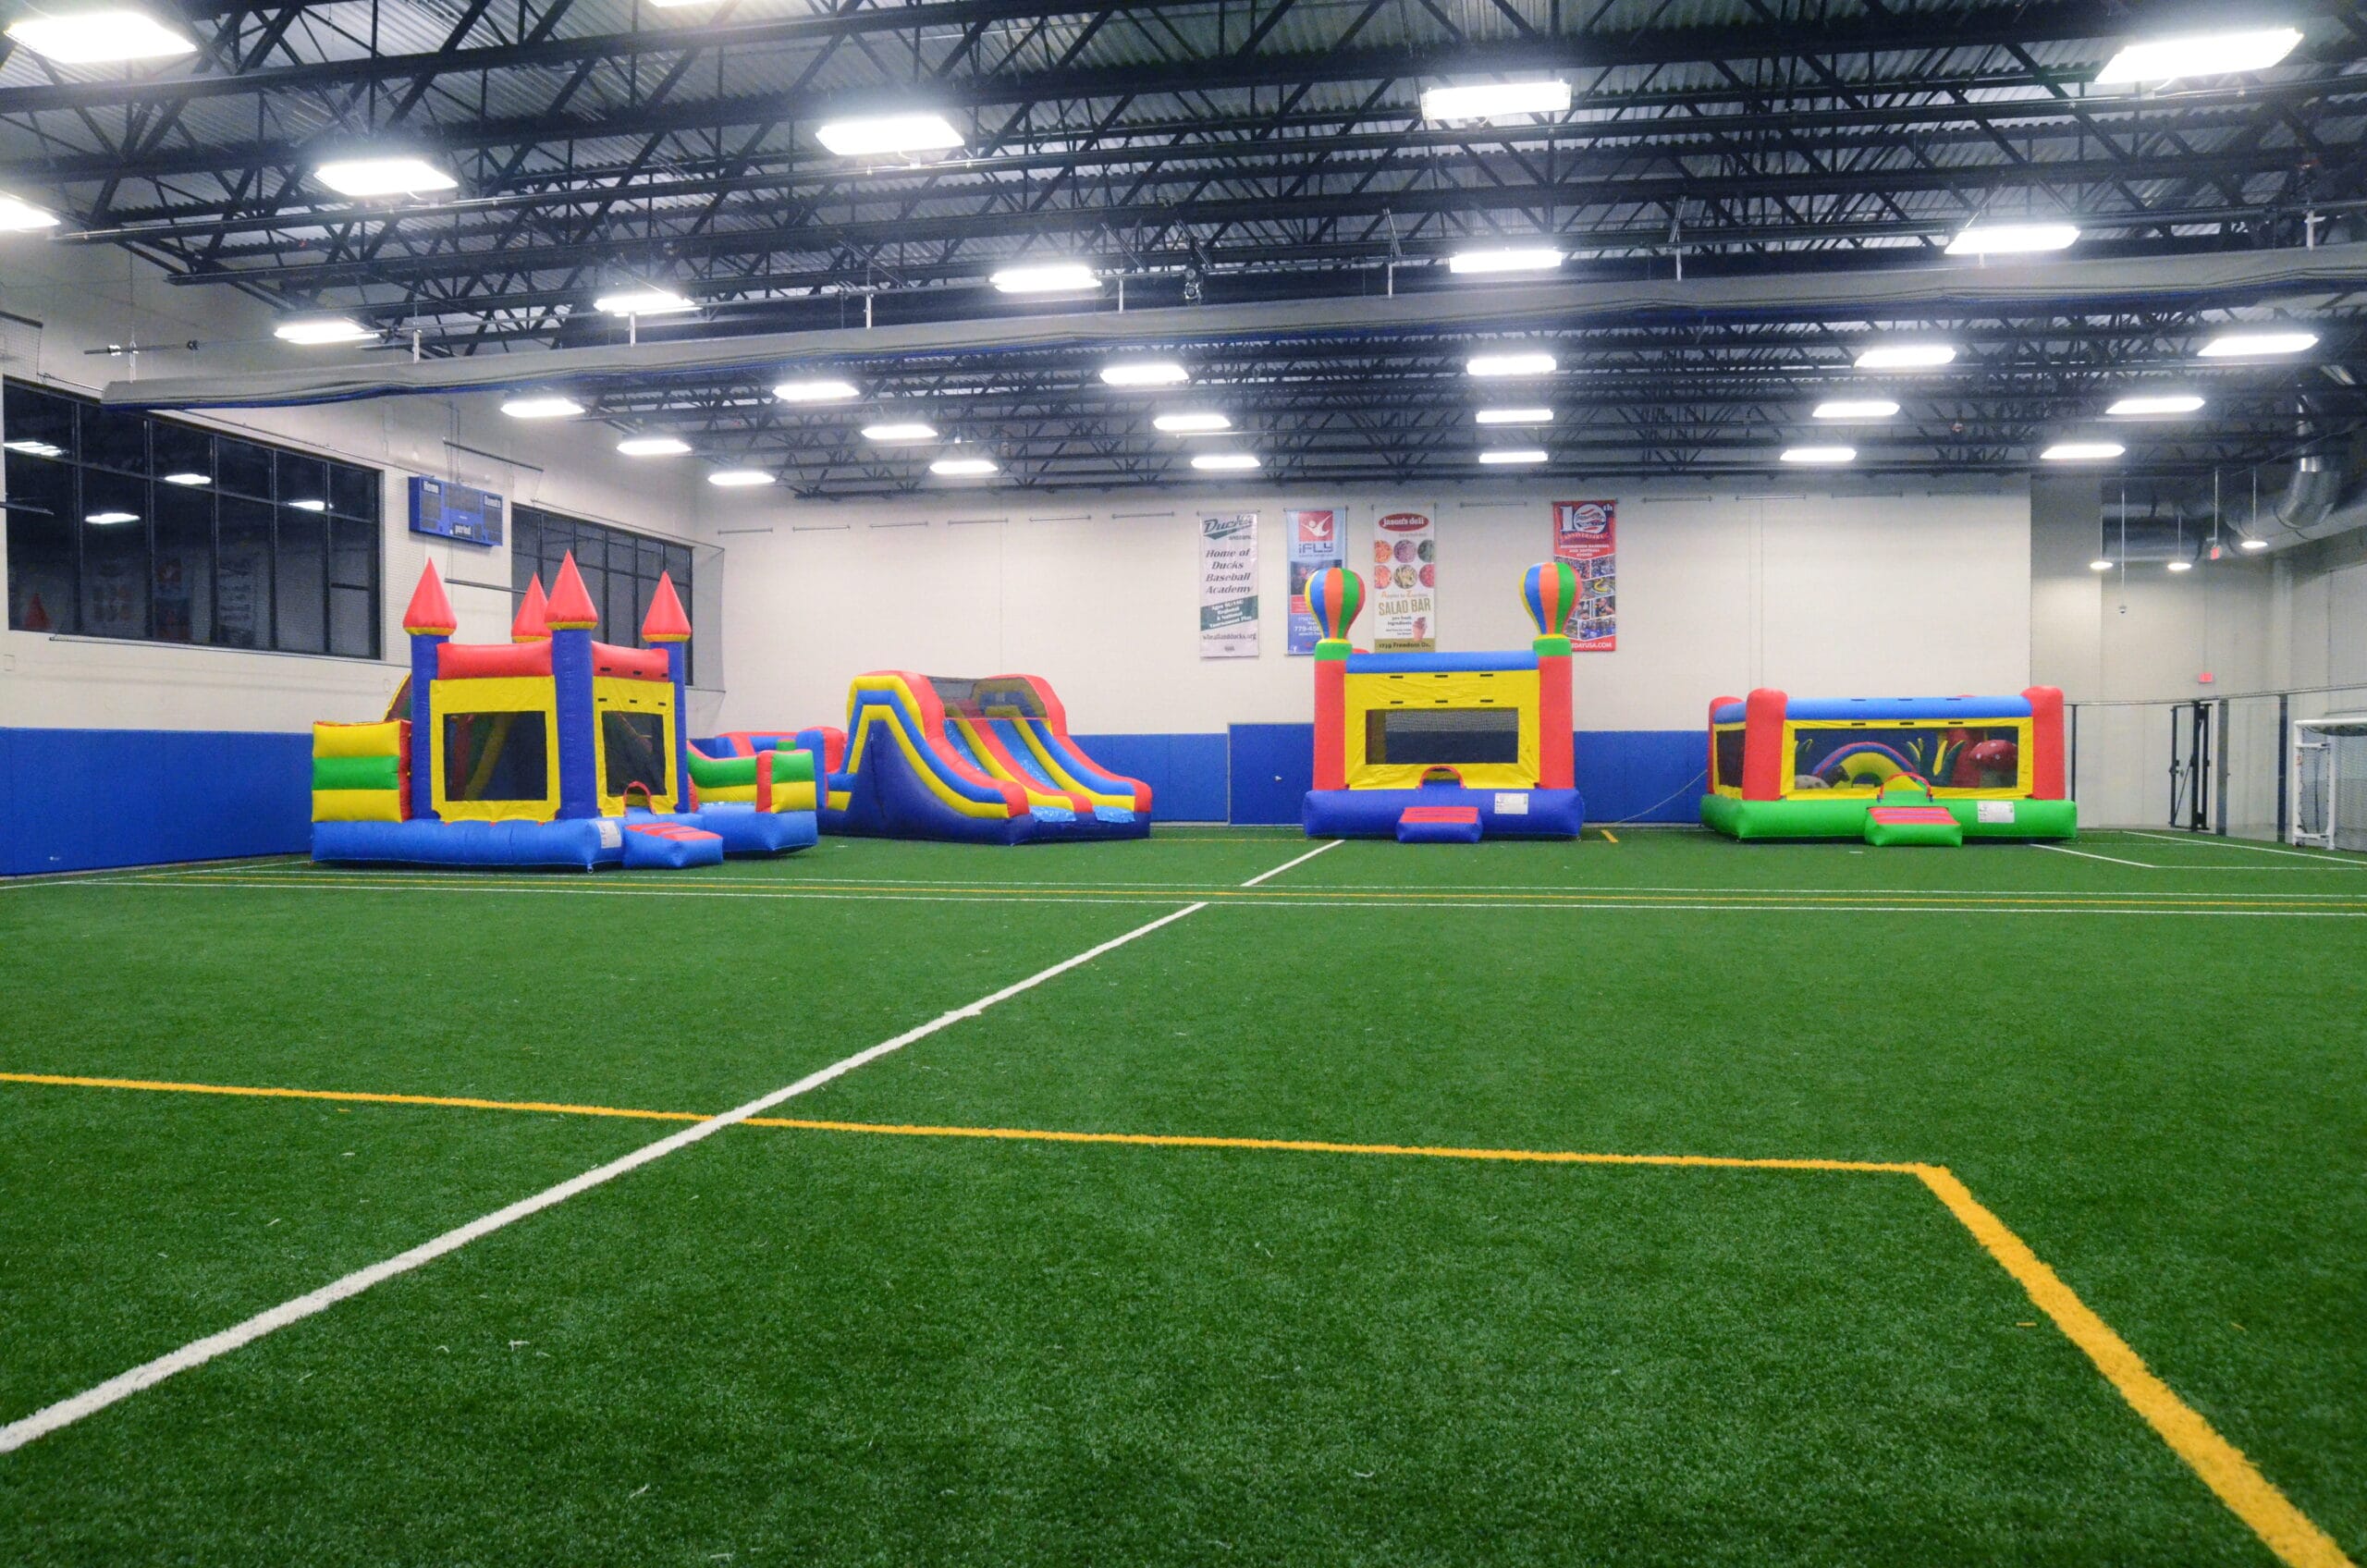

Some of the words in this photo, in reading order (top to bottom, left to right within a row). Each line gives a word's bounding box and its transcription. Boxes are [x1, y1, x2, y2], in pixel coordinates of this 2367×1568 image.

[423, 480, 439, 494] Home
[1206, 549, 1236, 557] Home
[1239, 547, 1251, 557] of
[1211, 561, 1244, 570] Ducks
[1206, 572, 1251, 582] Baseball
[1206, 585, 1253, 594] Academy
[1379, 600, 1409, 616] SALAD
[1412, 597, 1431, 612] BAR
